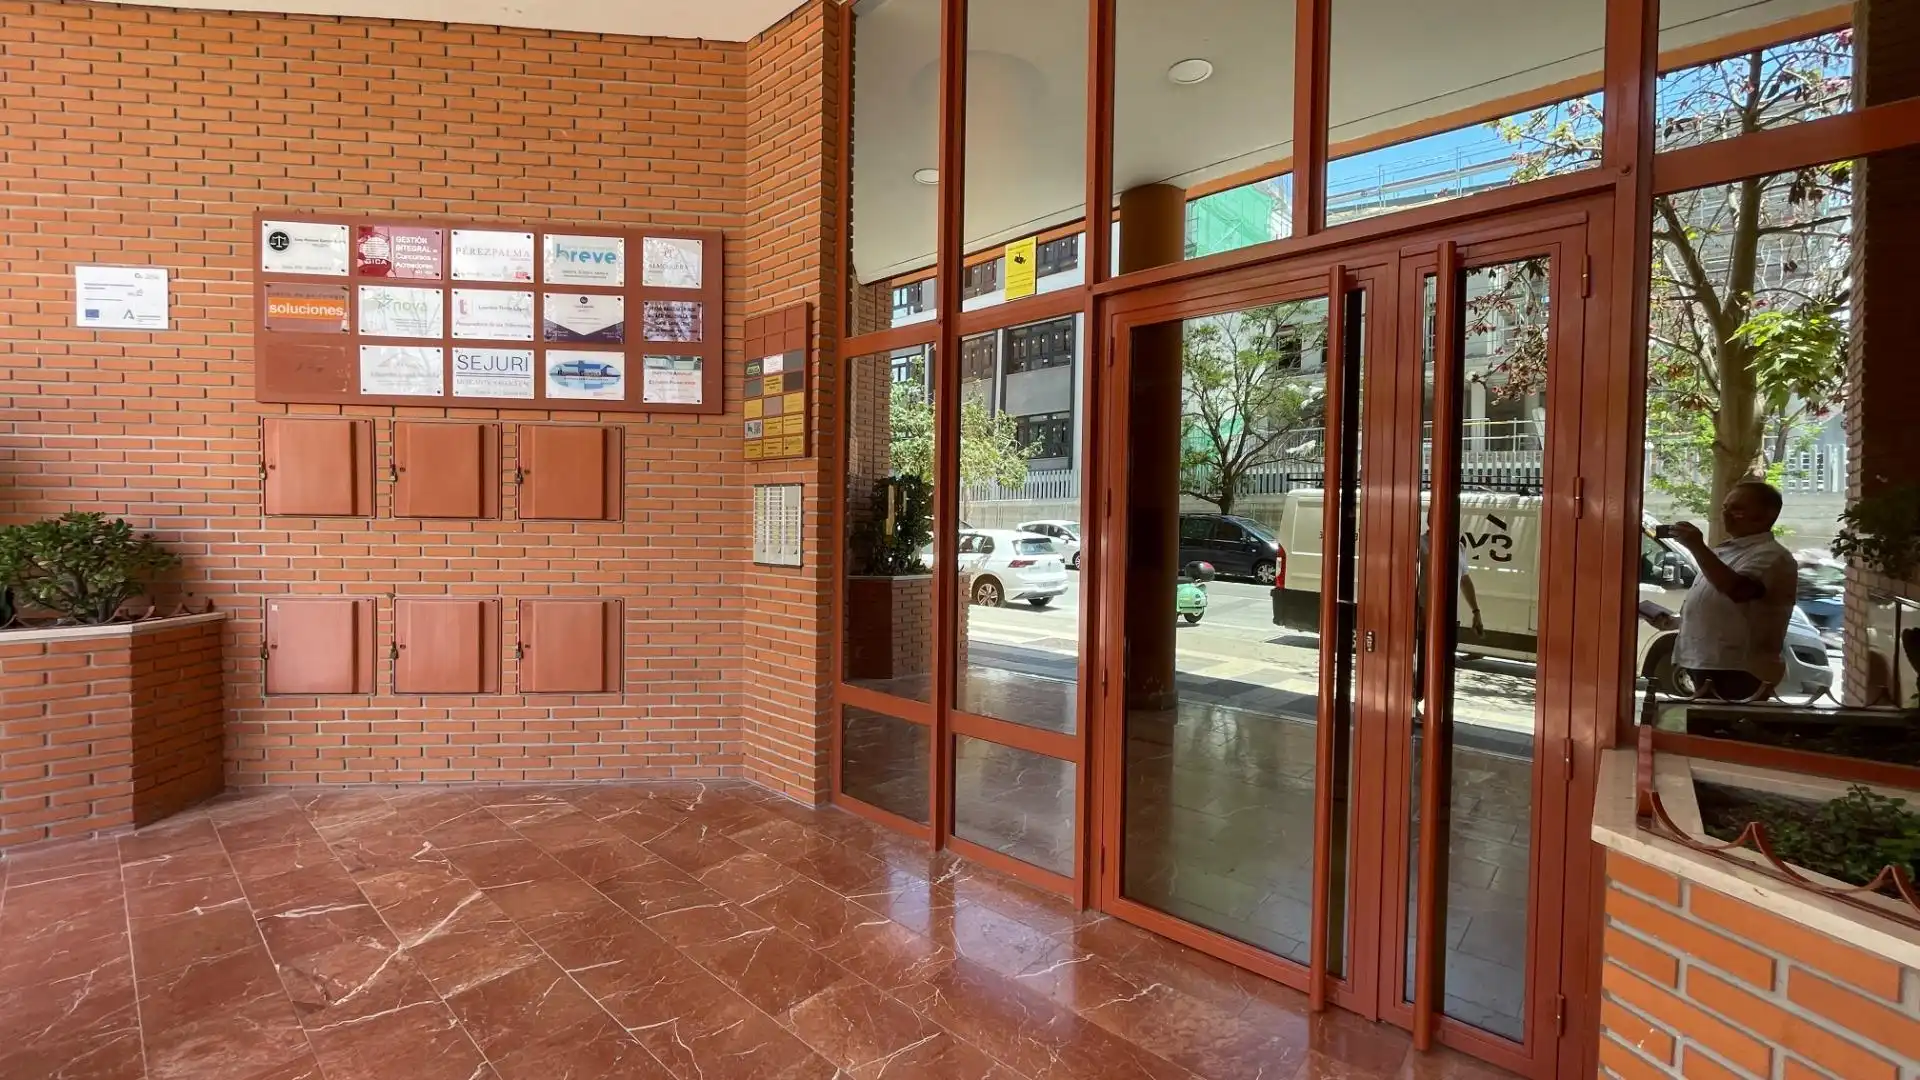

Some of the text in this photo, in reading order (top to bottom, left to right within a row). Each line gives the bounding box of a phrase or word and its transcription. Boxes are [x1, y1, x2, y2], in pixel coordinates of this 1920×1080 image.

[395, 235, 428, 244] GESTIÓN
[395, 244, 432, 253] INTEGRAL
[455, 244, 531, 257] PÉREZPALMA
[556, 244, 617, 264] breve
[269, 303, 345, 317] soluciones
[394, 301, 427, 312] nova
[457, 354, 528, 372] SEJURI
